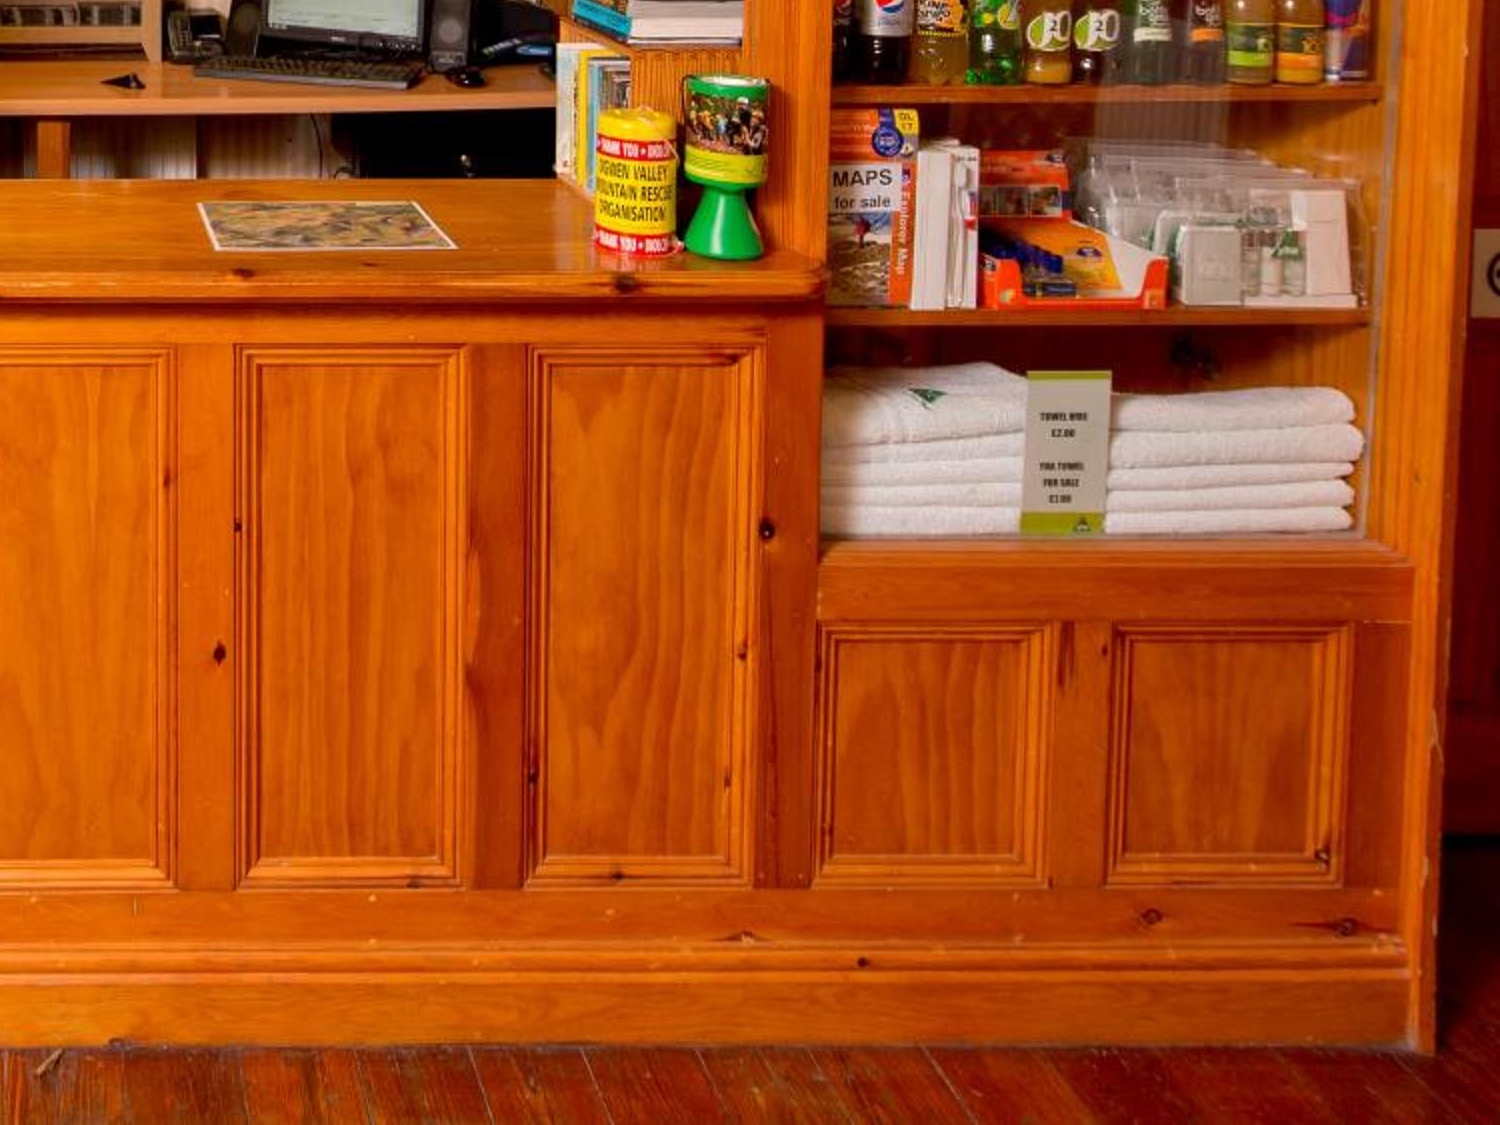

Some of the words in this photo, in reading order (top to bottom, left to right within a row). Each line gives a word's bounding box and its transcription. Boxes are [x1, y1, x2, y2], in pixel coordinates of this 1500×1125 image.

[633, 165, 669, 182] VALLEY
[833, 168, 893, 187] MAPS
[834, 195, 855, 209] for
[859, 194, 891, 208] sale
